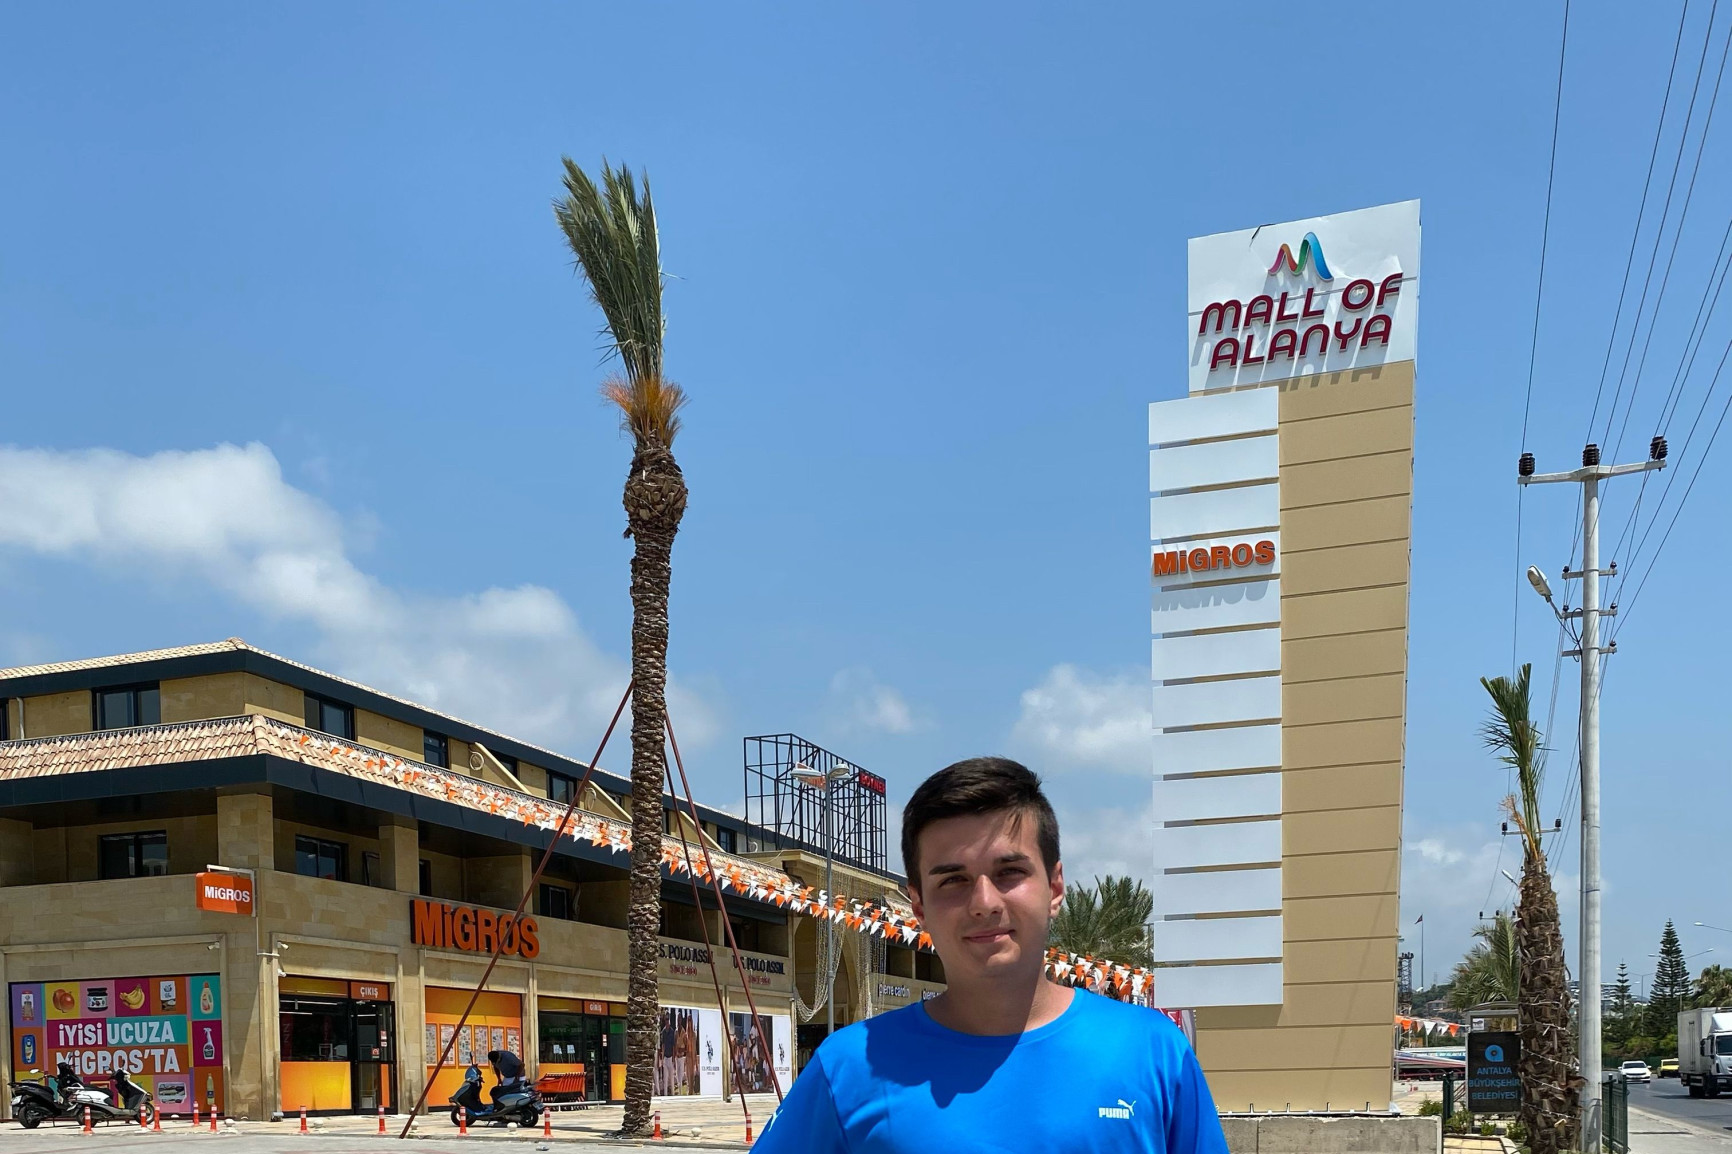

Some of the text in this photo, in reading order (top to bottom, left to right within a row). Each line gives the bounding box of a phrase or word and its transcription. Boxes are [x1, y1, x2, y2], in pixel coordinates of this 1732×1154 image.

[1199, 272, 1403, 336] MALL OF
[1210, 313, 1392, 371] ALANYA
[669, 944, 692, 962] POLO
[106, 1020, 175, 1045] UCUZA
[1476, 1066, 1513, 1076] ANTALYA
[1098, 1107, 1130, 1119] PUMA
